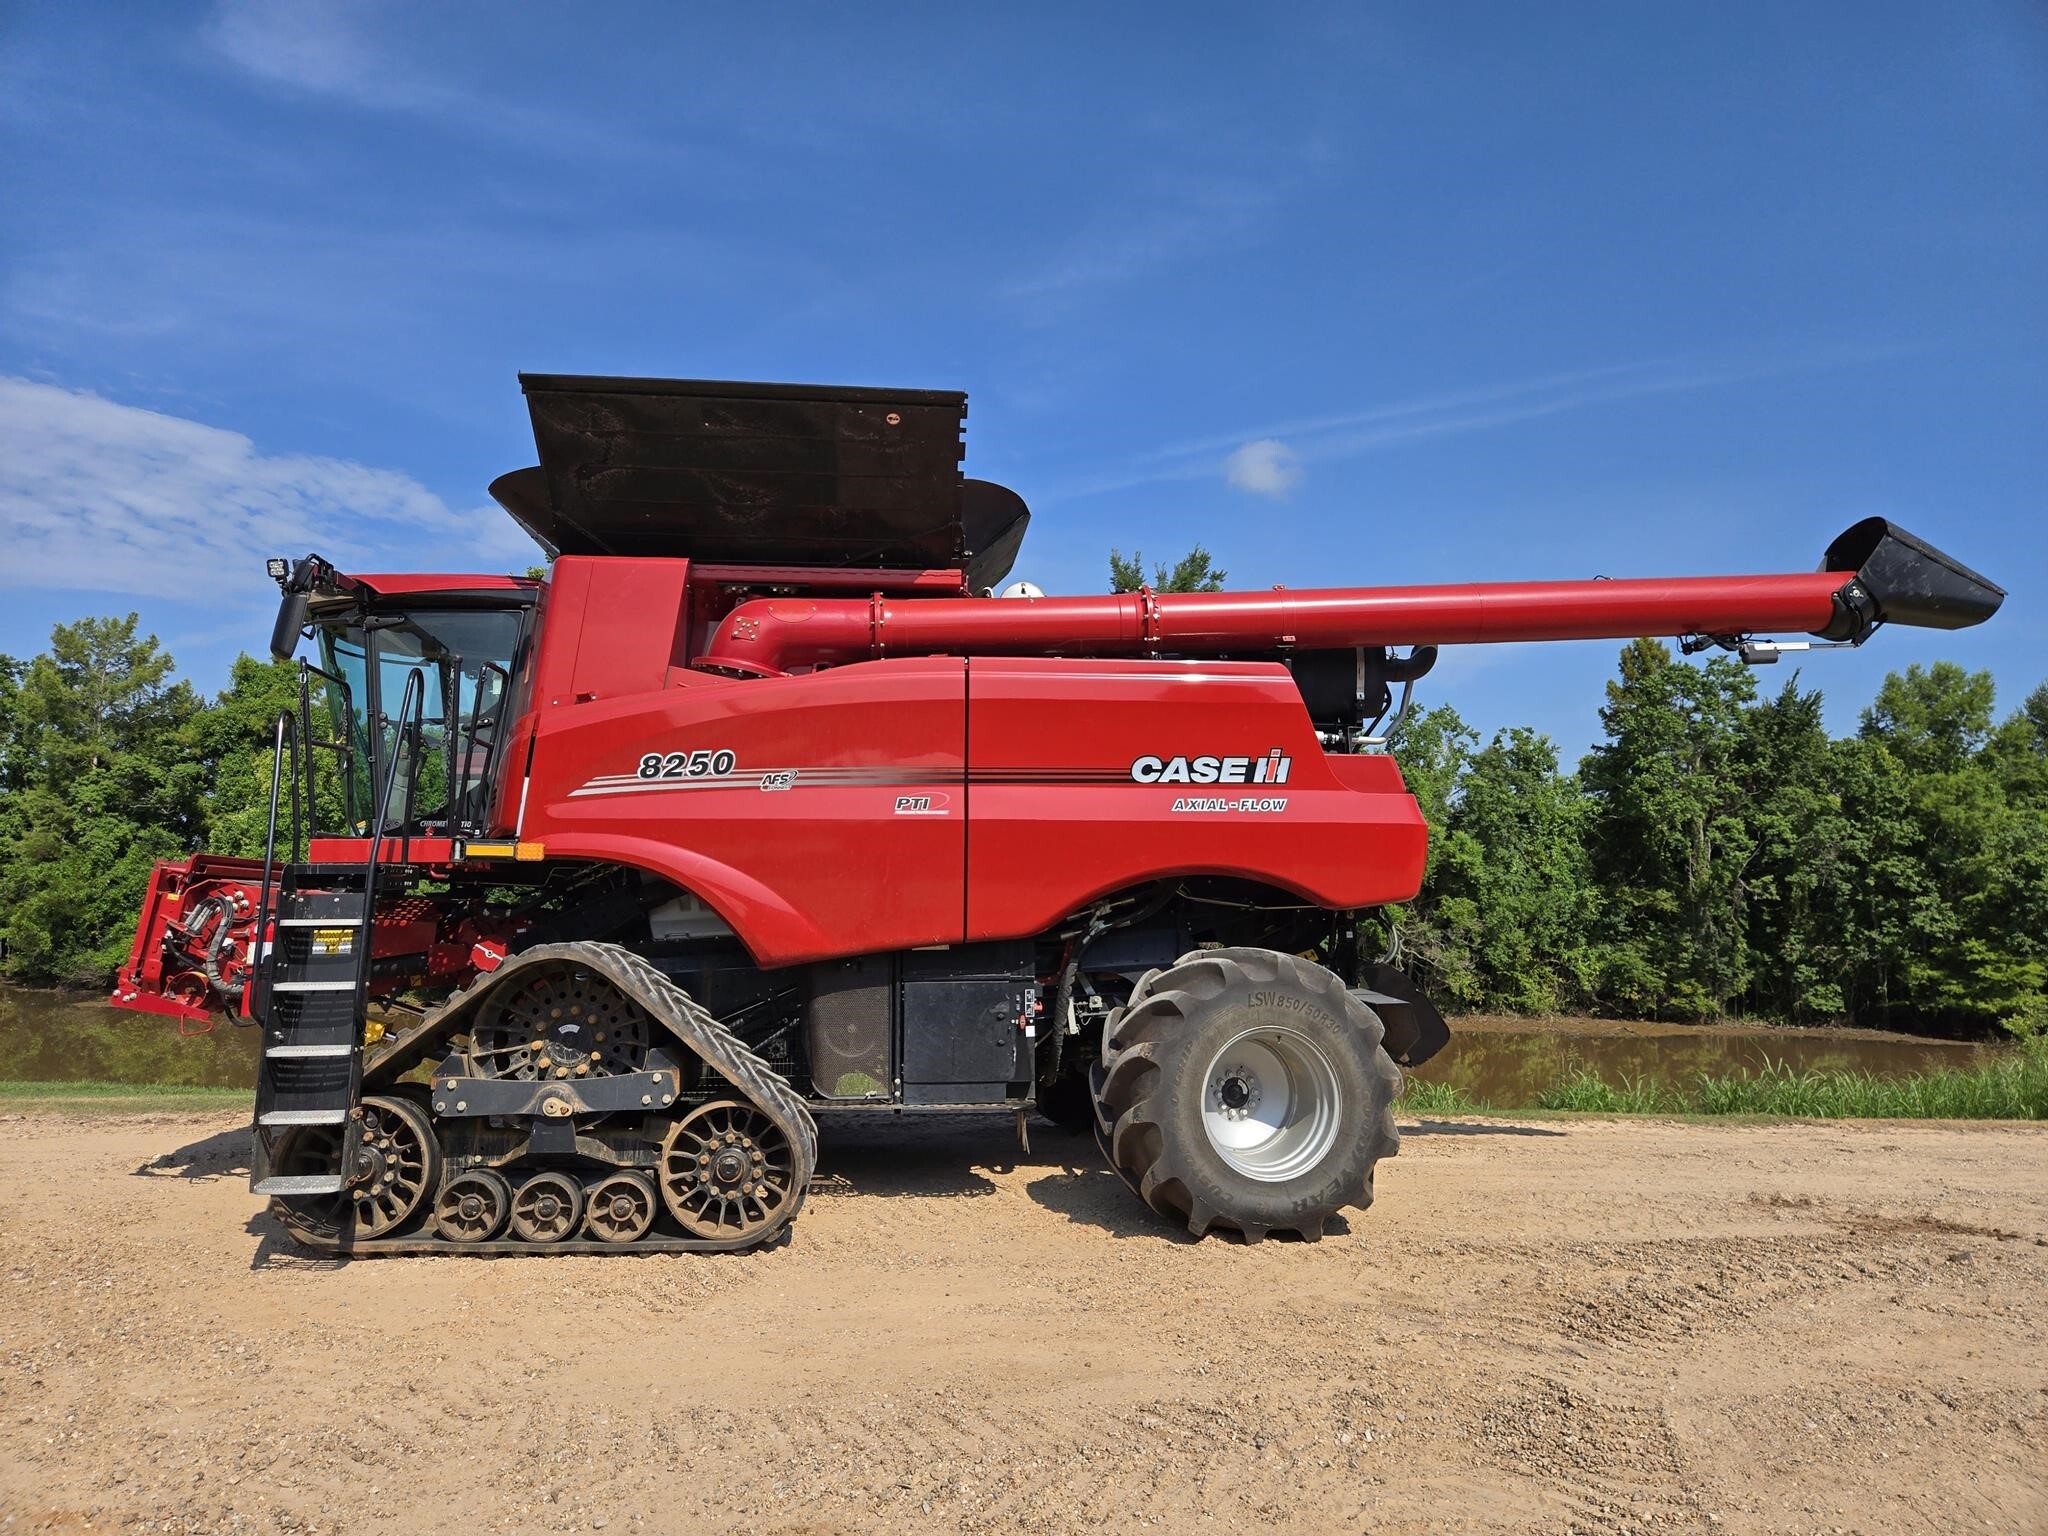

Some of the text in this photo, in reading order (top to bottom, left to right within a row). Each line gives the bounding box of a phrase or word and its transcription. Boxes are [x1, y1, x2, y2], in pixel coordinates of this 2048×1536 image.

[638, 750, 735, 779] 8250
[1131, 756, 1249, 783] CASE
[761, 773, 790, 785] AFS
[895, 797, 930, 810] PTI
[1172, 798, 1288, 812] AXIAL-FLOW
